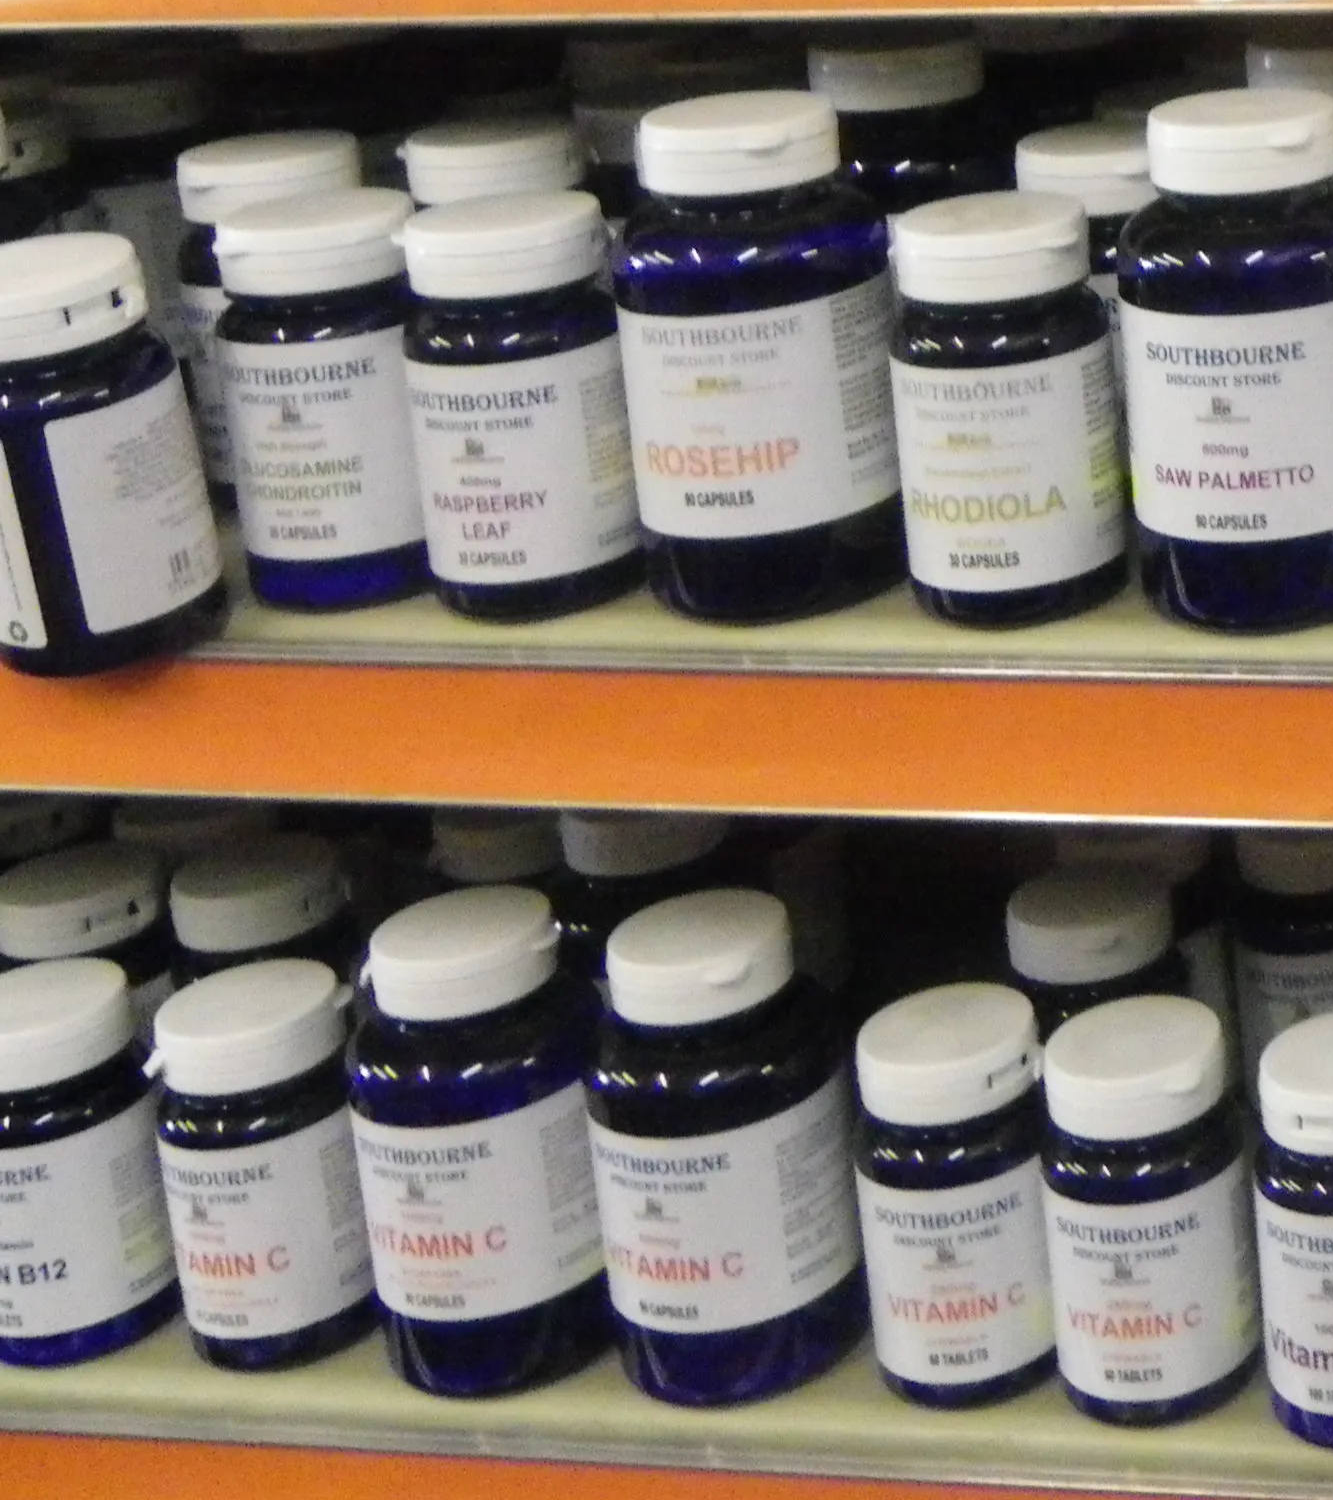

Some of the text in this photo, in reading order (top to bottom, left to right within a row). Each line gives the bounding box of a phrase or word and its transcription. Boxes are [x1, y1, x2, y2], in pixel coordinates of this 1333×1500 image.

[1146, 341, 1306, 367] SOUTHBOURNE
[645, 438, 800, 479] ROSEHIP
[1155, 464, 1314, 490] SAW PALMETTO
[433, 490, 549, 513] RASPBERRY
[697, 489, 754, 507] CAPSULES
[911, 485, 1066, 525] RHODIOLA
[462, 521, 511, 542] LEAF
[1209, 514, 1268, 529] CAPSULES
[961, 551, 1019, 568] CAPSULES
[371, 1221, 507, 1259] VITAMIN C
[1057, 1213, 1200, 1242] SOUTHBOURNE
[267, 1246, 290, 1271] C
[608, 1244, 744, 1283] VITAMIN C
[18, 1259, 68, 1286] B12
[888, 1283, 1026, 1323] VITAMIN C
[1067, 1305, 1201, 1339] VITAMIN C
